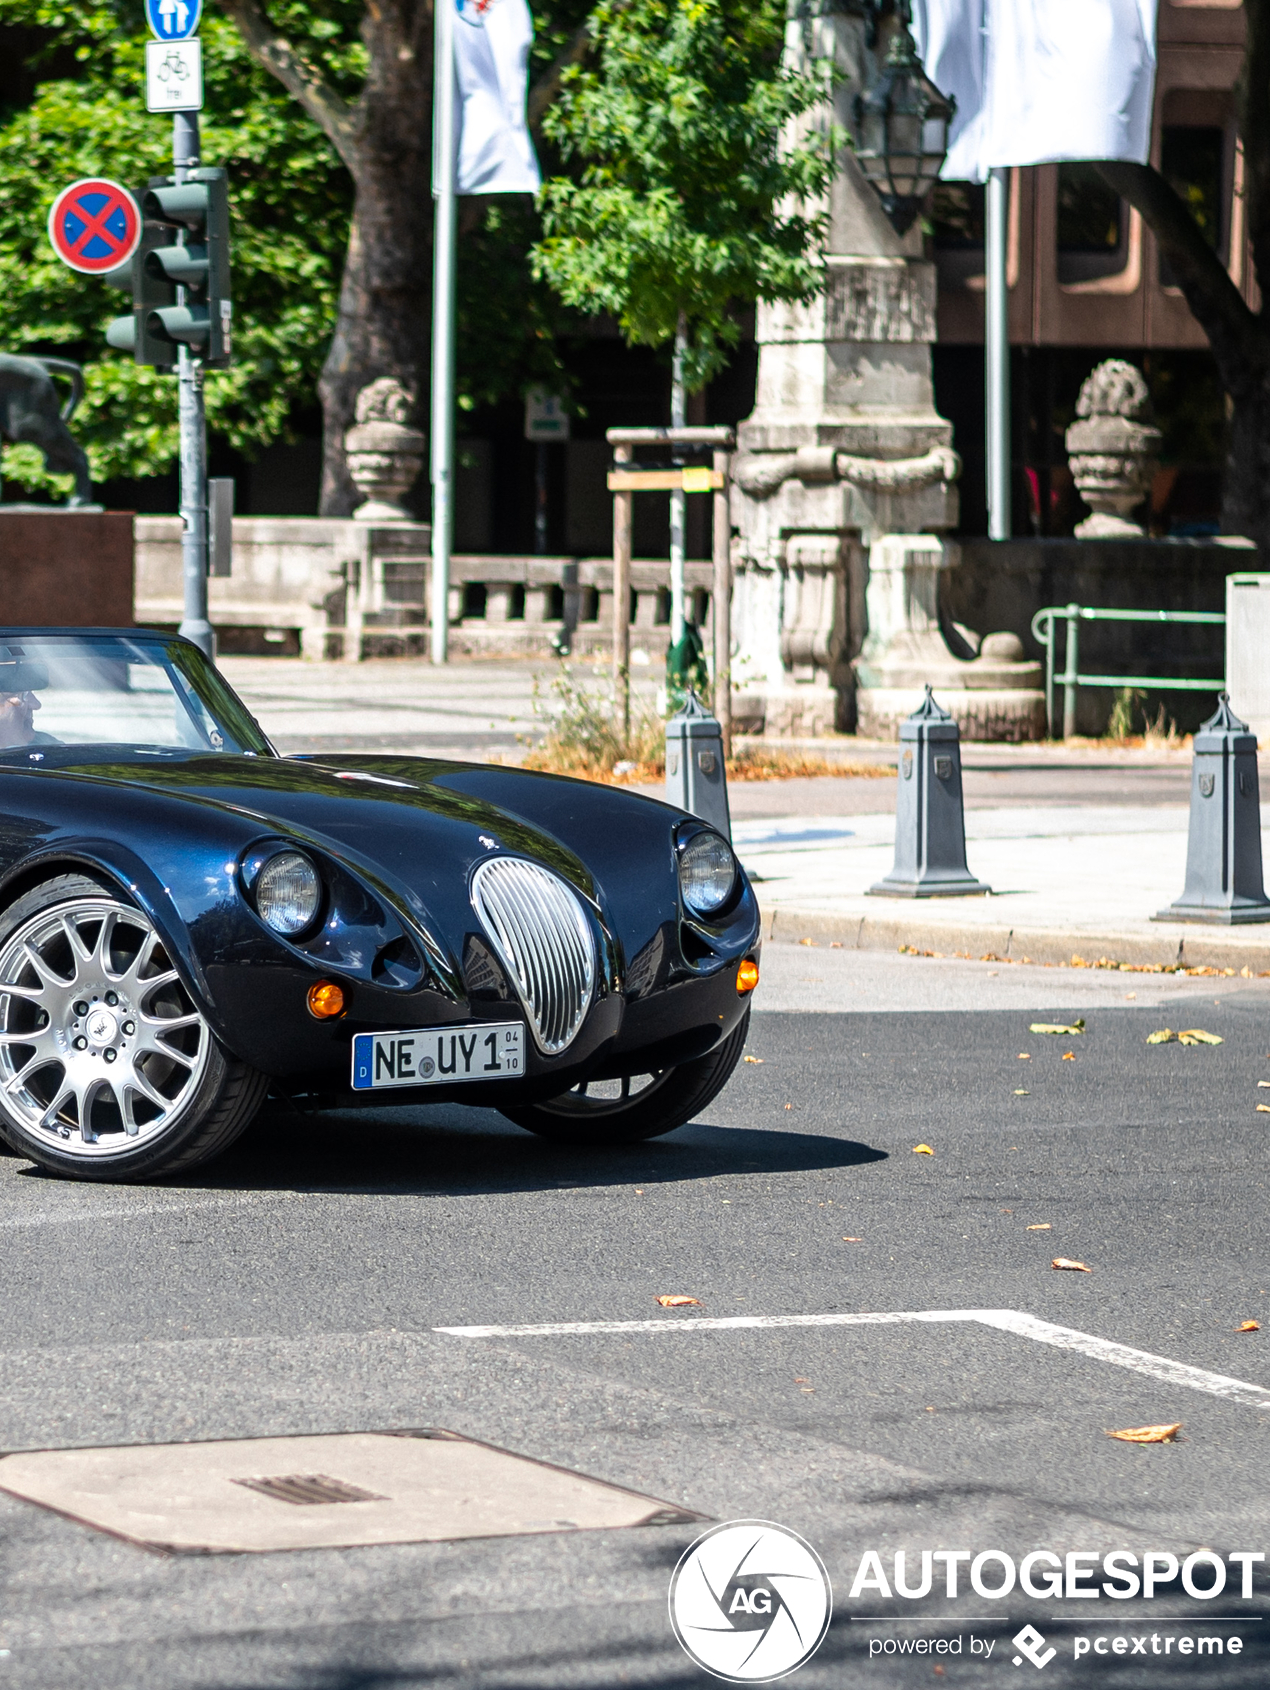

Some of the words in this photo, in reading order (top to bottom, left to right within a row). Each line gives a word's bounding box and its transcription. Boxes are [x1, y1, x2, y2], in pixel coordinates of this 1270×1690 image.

[505, 1030, 518, 1042] 04
[375, 1039, 416, 1080] NE
[437, 1034, 477, 1074] UY
[483, 1032, 501, 1071] 1
[506, 1058, 518, 1070] 10
[359, 1066, 367, 1078] D
